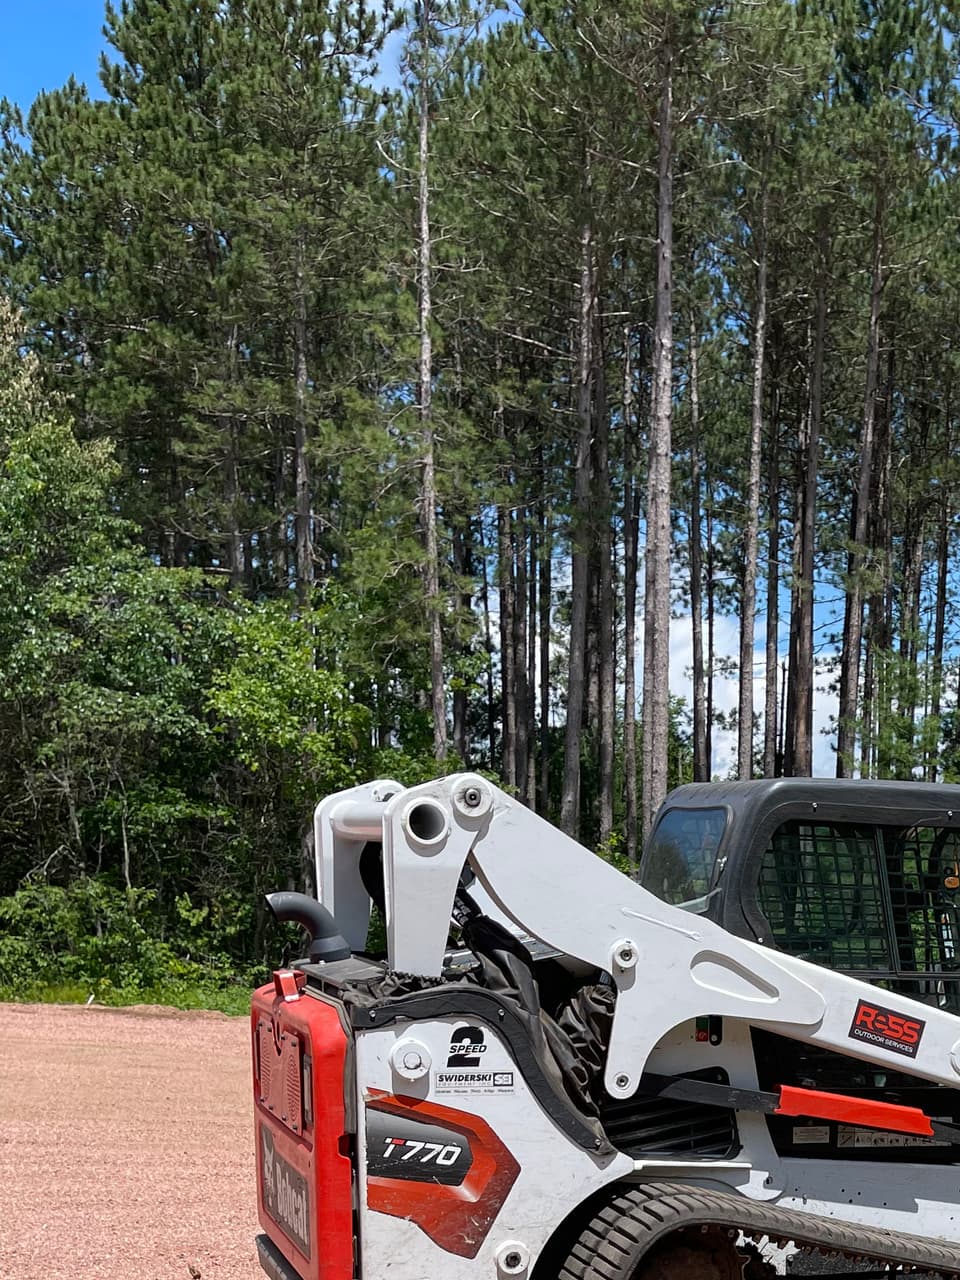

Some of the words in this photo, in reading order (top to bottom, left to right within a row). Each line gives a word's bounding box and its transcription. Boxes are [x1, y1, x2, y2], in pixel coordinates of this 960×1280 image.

[447, 1026, 484, 1067] 2
[449, 1044, 487, 1054] SPEED
[854, 1028, 886, 1043] OUTDOOR
[884, 1039, 914, 1053] SERVICES
[438, 1073, 492, 1082] SWIDERSKI
[383, 1137, 462, 1166] T770
[275, 1161, 308, 1246] Bobcat
